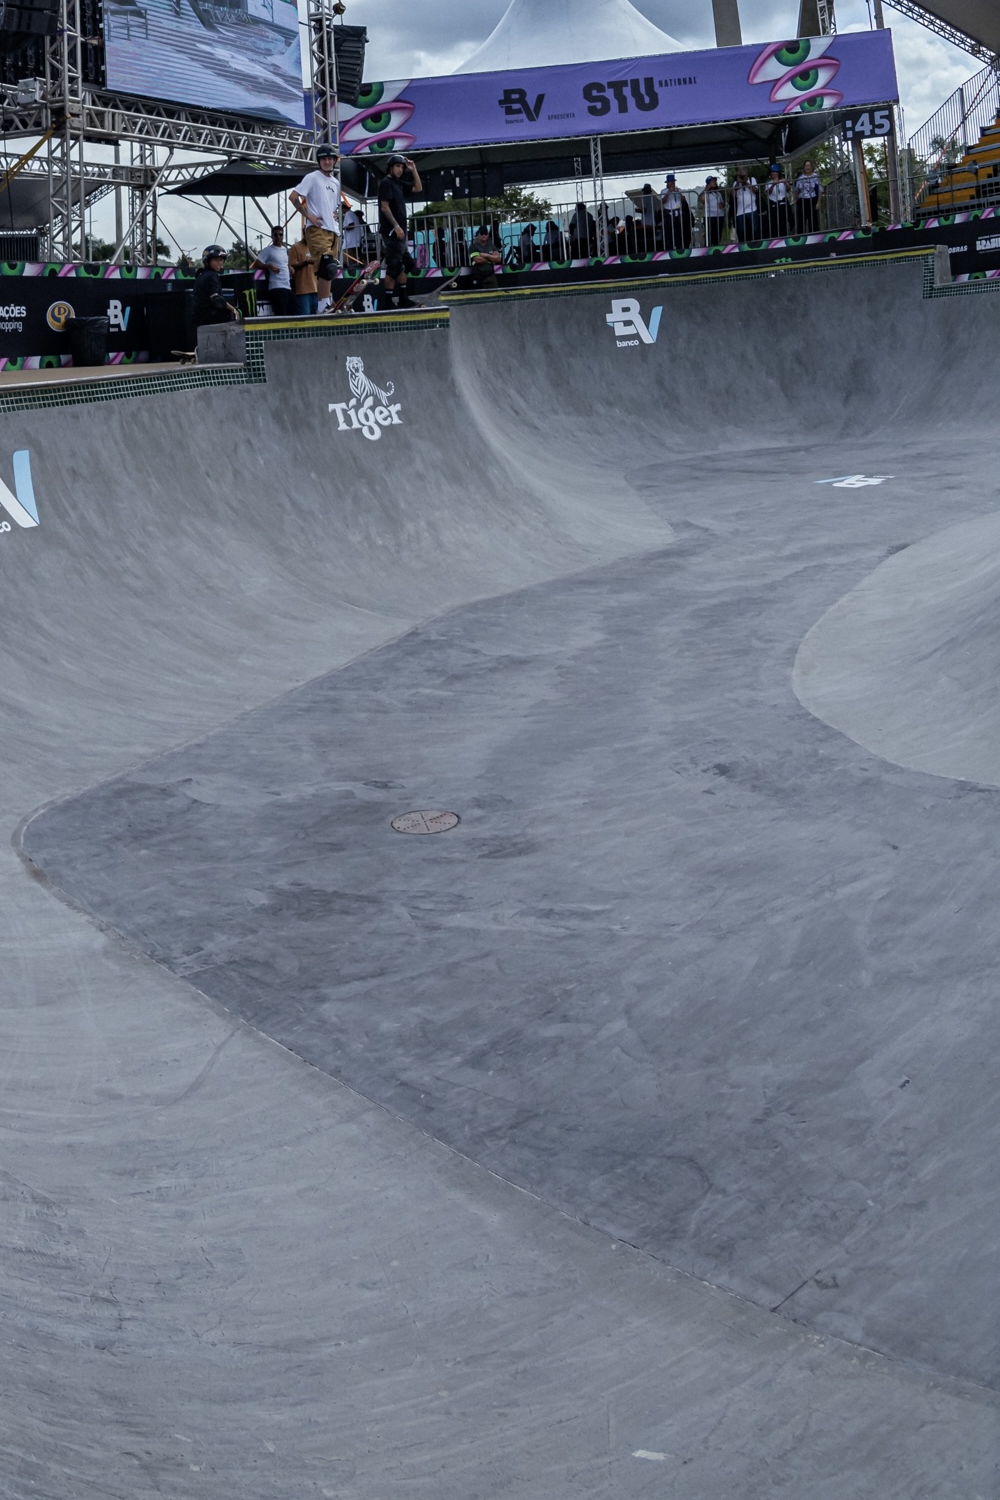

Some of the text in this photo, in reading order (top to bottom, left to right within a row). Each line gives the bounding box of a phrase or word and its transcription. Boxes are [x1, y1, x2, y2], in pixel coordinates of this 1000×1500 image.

[583, 76, 698, 117] STU NATIONAL
[547, 112, 576, 121] APRESENTA
[845, 110, 891, 138] :45
[616, 339, 640, 348] banco
[328, 396, 403, 441] Tiger
